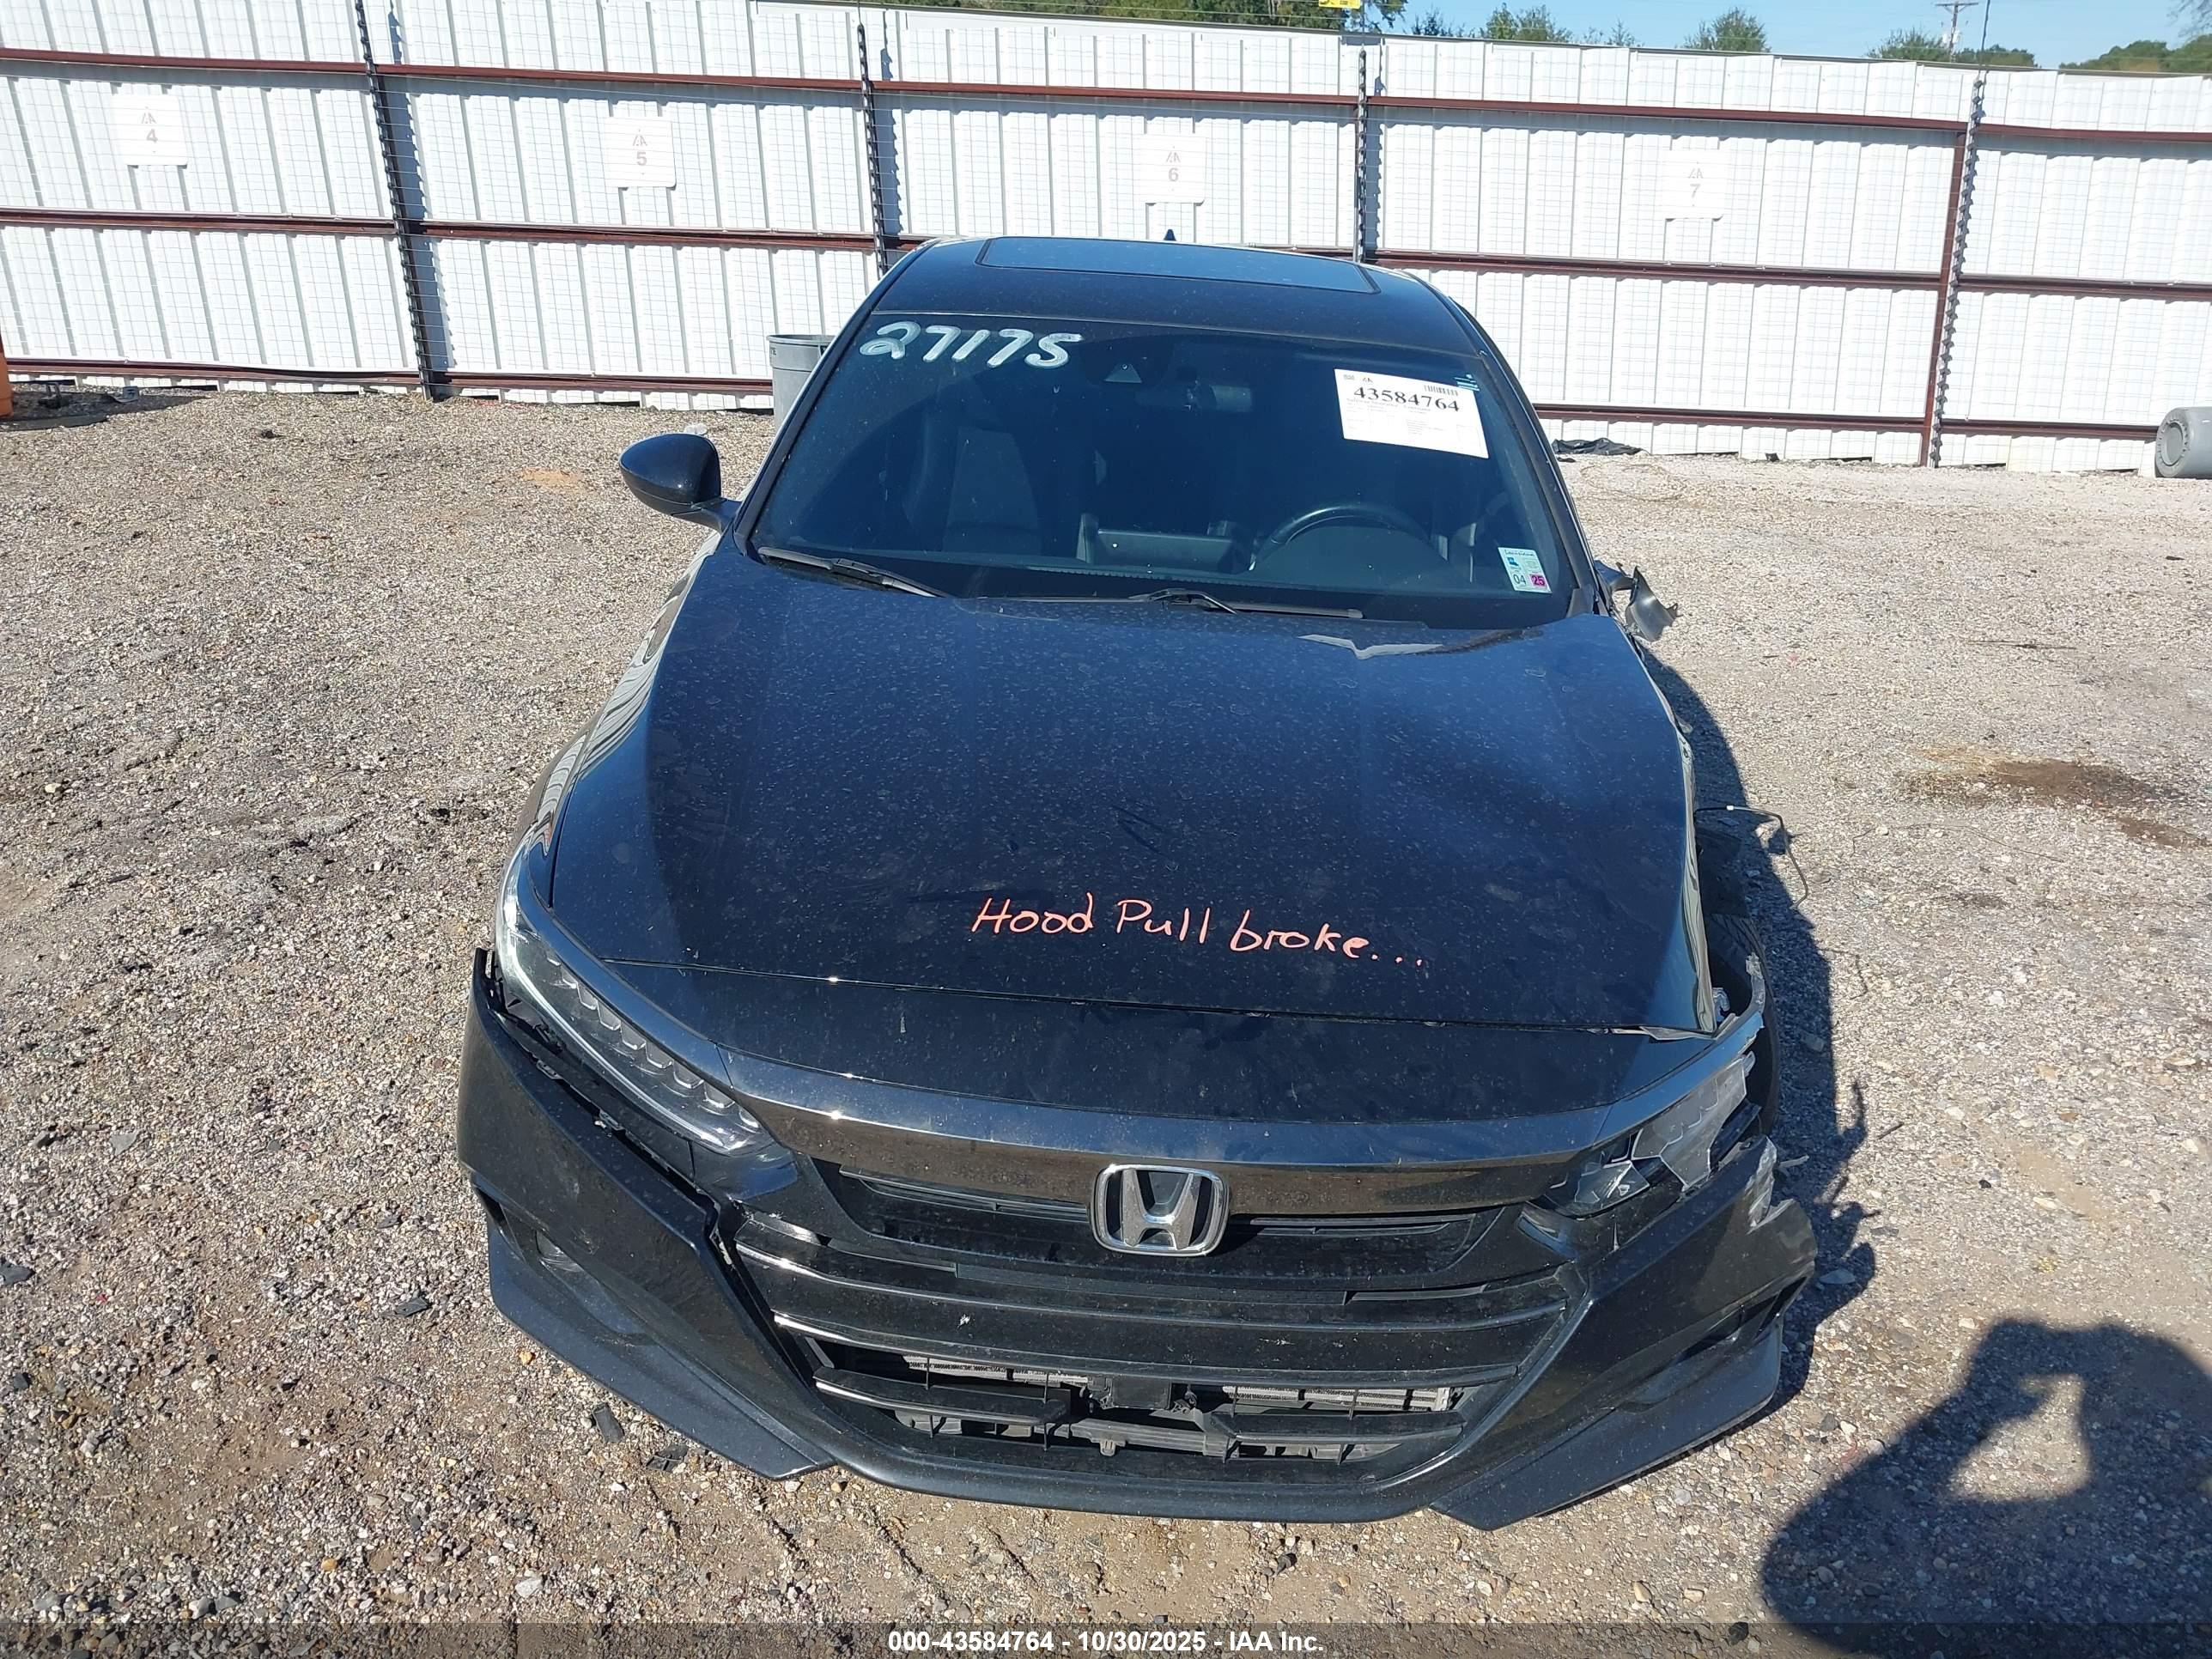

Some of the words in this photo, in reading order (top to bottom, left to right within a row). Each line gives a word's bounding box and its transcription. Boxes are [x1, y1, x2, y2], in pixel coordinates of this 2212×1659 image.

[146, 128, 159, 143] 4
[636, 151, 647, 166] 5
[1168, 167, 1179, 182] 6
[1689, 183, 1701, 198] 7
[860, 320, 1084, 369] 27175
[1353, 386, 1460, 412] 43584764
[1513, 574, 1527, 585] 04
[1531, 575, 1545, 586] 25
[971, 892, 1093, 933] Hood
[1116, 899, 1210, 943] Pull
